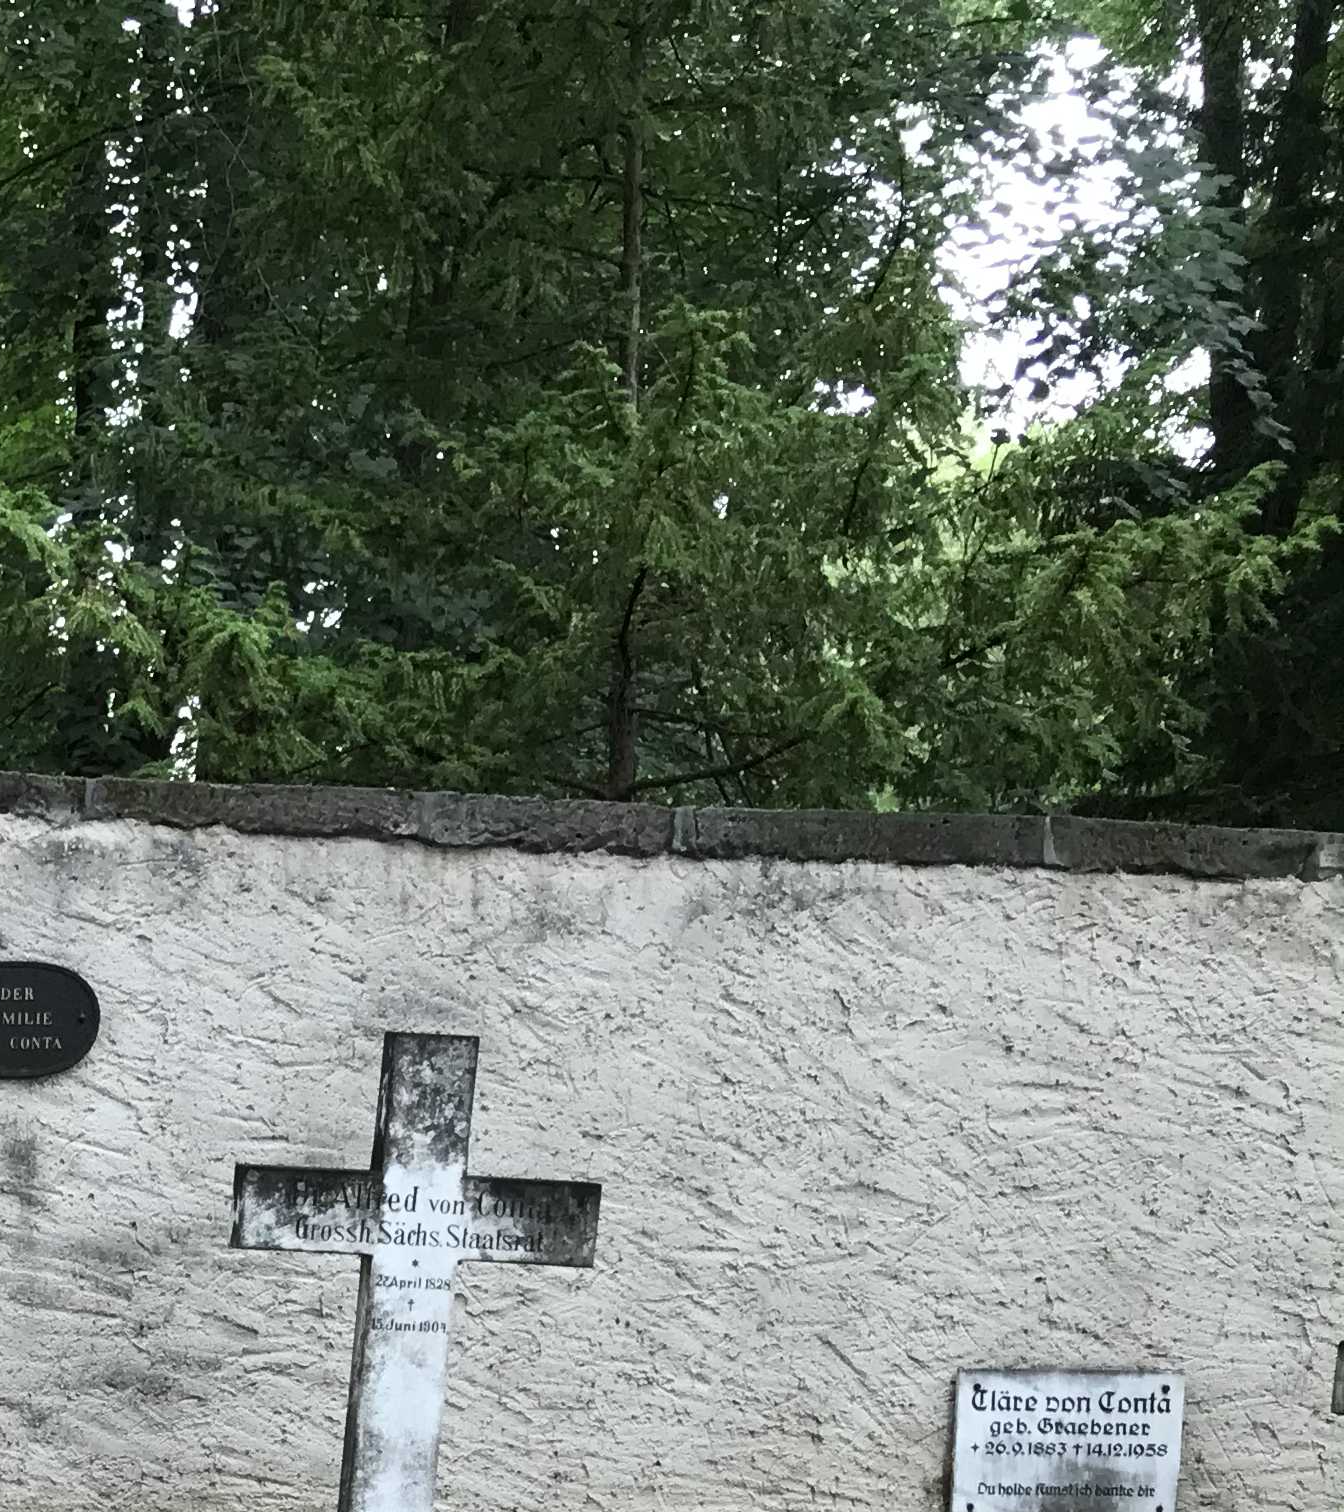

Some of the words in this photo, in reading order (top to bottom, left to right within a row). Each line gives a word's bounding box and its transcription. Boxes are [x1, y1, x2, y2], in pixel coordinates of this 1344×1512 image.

[0, 987, 34, 1001] DER
[10, 1037, 63, 1050] CONTA
[331, 1182, 419, 1213] Alfred
[429, 1198, 465, 1216] von
[376, 1220, 443, 1248] Sächs.
[446, 1224, 544, 1252] Staatsrat
[385, 1317, 417, 1332] Juni
[1045, 1396, 1091, 1413] von
[1098, 1391, 1171, 1414] Conta
[989, 1418, 1032, 1437] geb.
[1036, 1418, 1151, 1436] Graebener
[977, 1482, 996, 1496] Du
[998, 1483, 1032, 1497] holde
[1094, 1484, 1135, 1497] danke
[1137, 1484, 1156, 1497] dir
